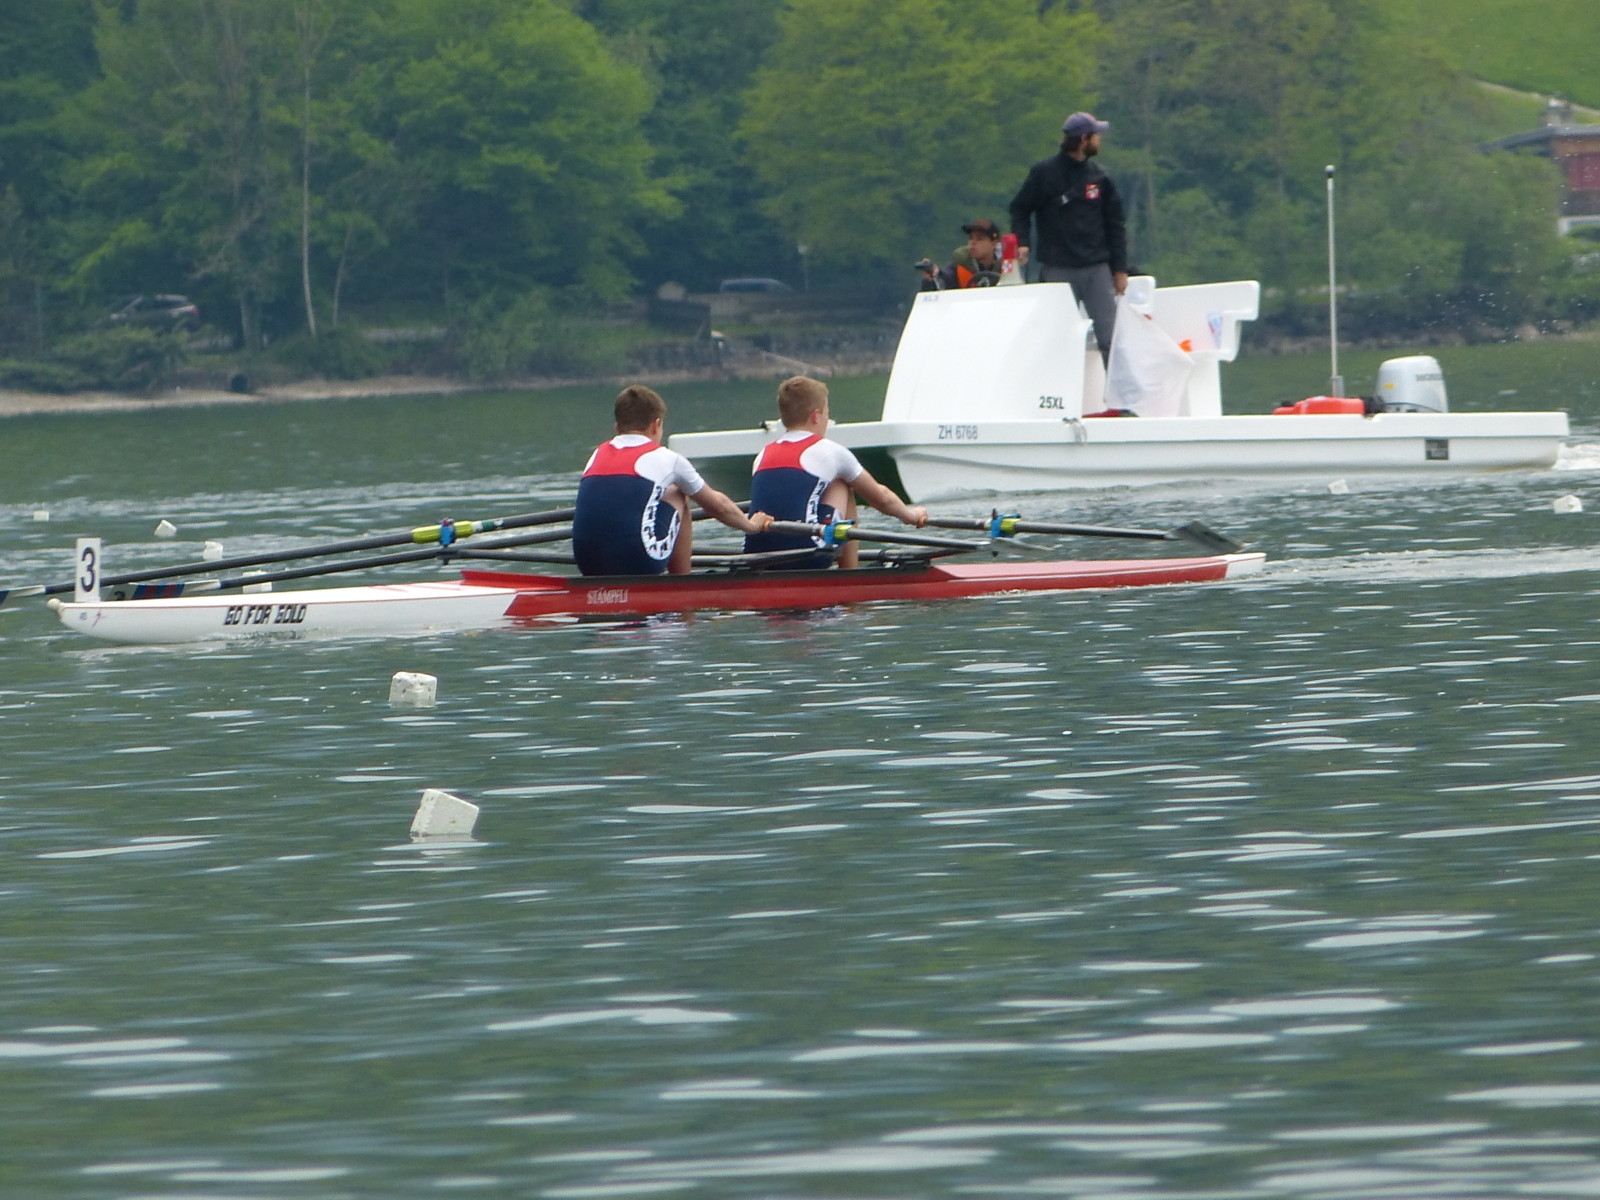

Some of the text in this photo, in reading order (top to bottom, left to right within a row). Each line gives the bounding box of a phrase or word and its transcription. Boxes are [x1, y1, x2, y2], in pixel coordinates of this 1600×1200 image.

[1039, 396, 1065, 409] 25XL
[938, 425, 978, 440] ZH 6768
[81, 547, 95, 592] 3
[224, 603, 306, 625] GO FOR GOLD
